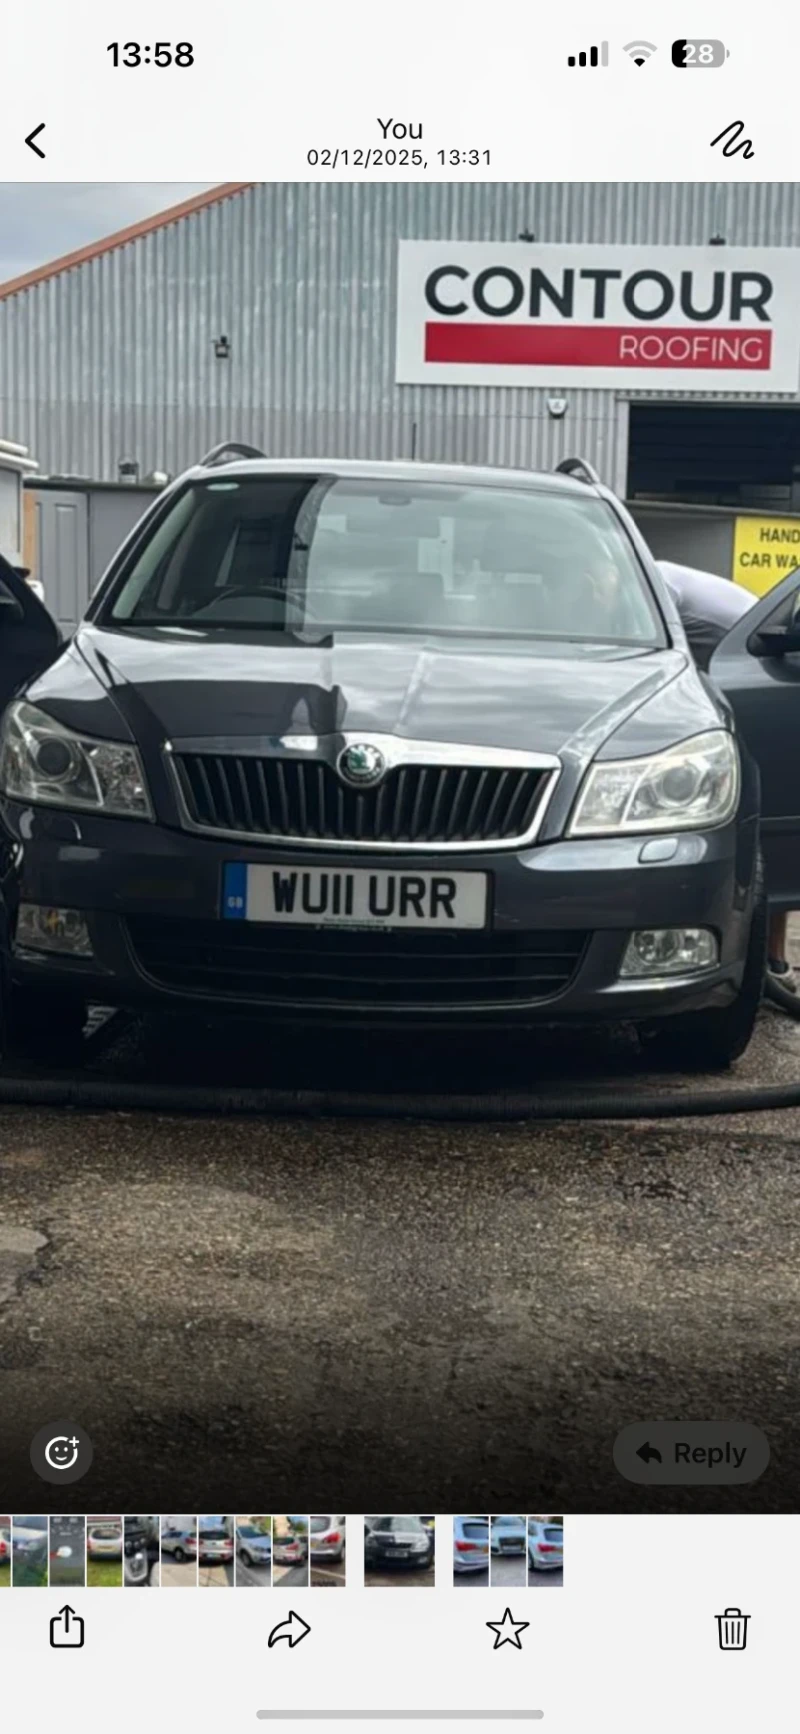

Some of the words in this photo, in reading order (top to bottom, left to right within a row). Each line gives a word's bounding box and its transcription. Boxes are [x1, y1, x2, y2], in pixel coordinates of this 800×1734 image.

[424, 265, 774, 322] CONTOUR
[619, 335, 763, 363] ROOFING
[759, 527, 800, 544] HAND
[740, 551, 771, 568] CAR
[775, 554, 800, 569] WA
[272, 870, 355, 916] WU11
[368, 874, 457, 919] URR
